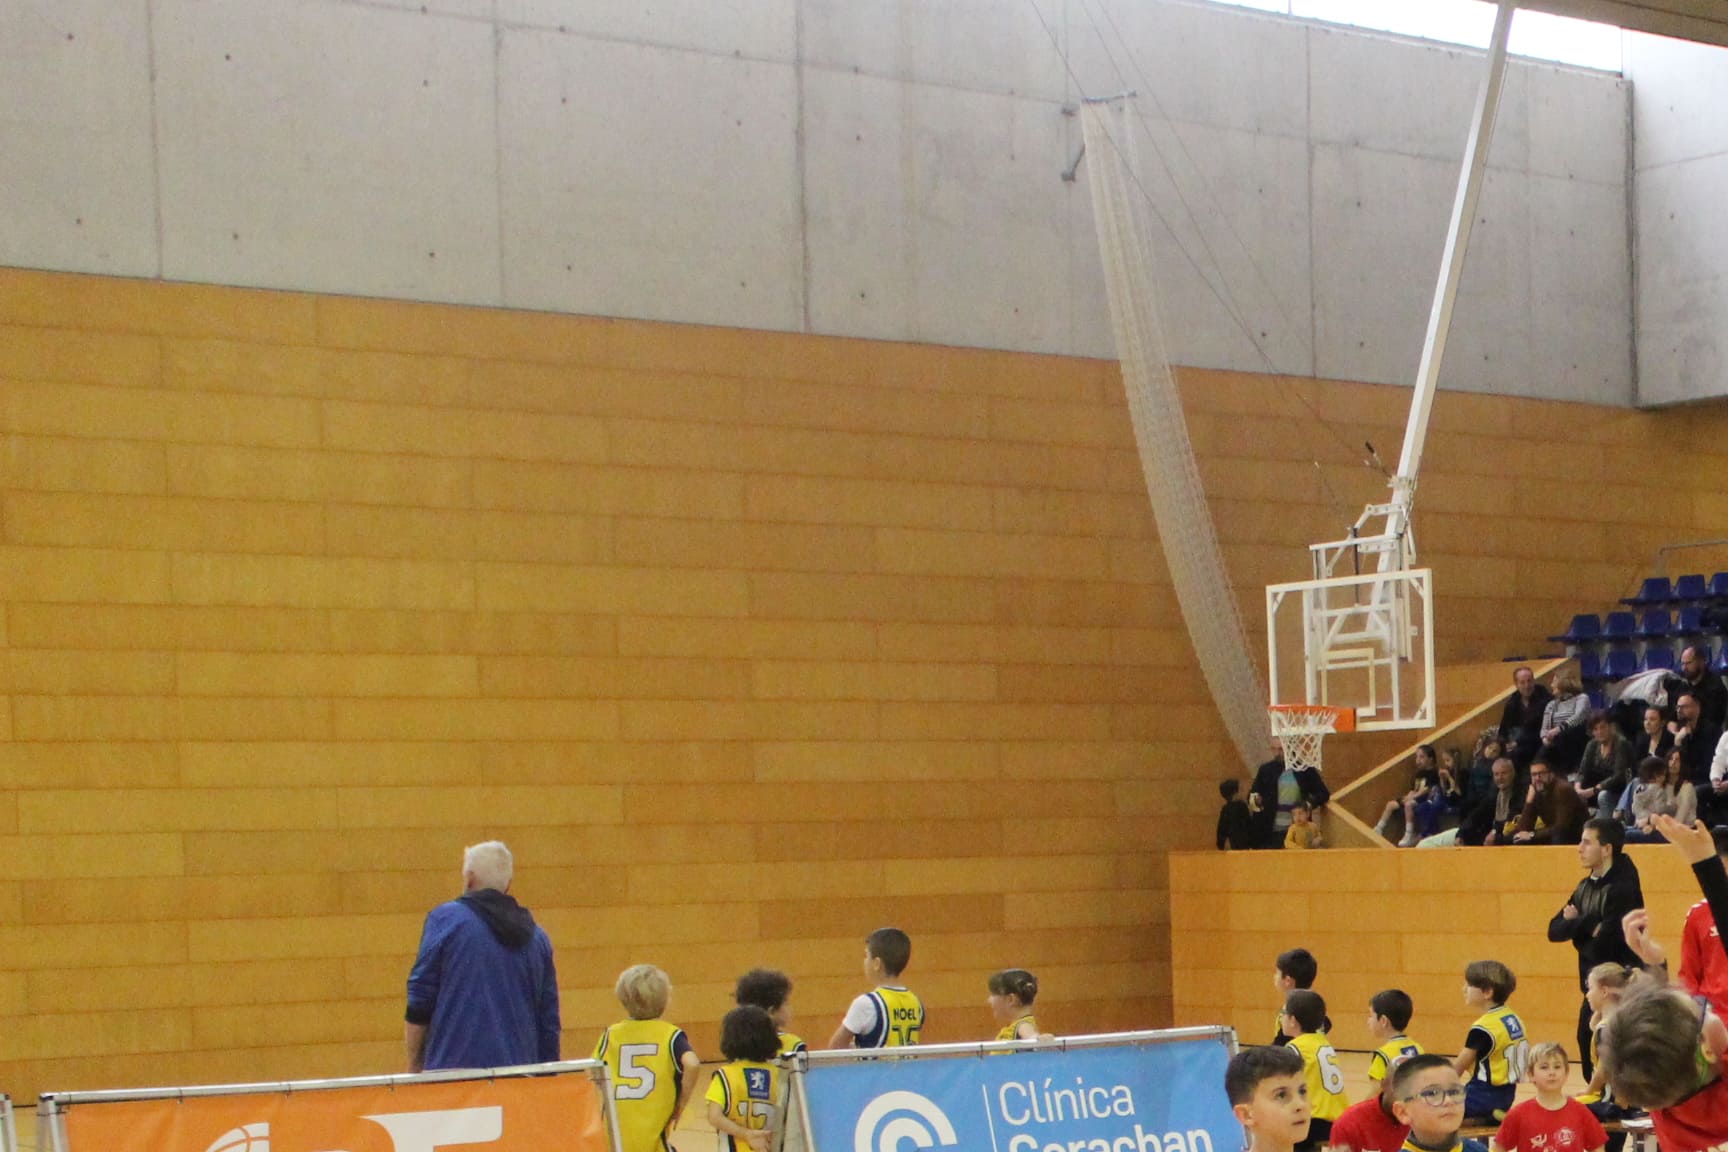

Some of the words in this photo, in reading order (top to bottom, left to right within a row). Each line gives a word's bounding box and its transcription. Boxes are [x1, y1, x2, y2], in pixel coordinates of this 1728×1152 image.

[893, 1007, 917, 1021] NOEL
[614, 1043, 659, 1100] 5
[1316, 1045, 1345, 1095] 6
[1000, 1077, 1136, 1126] Clínica
